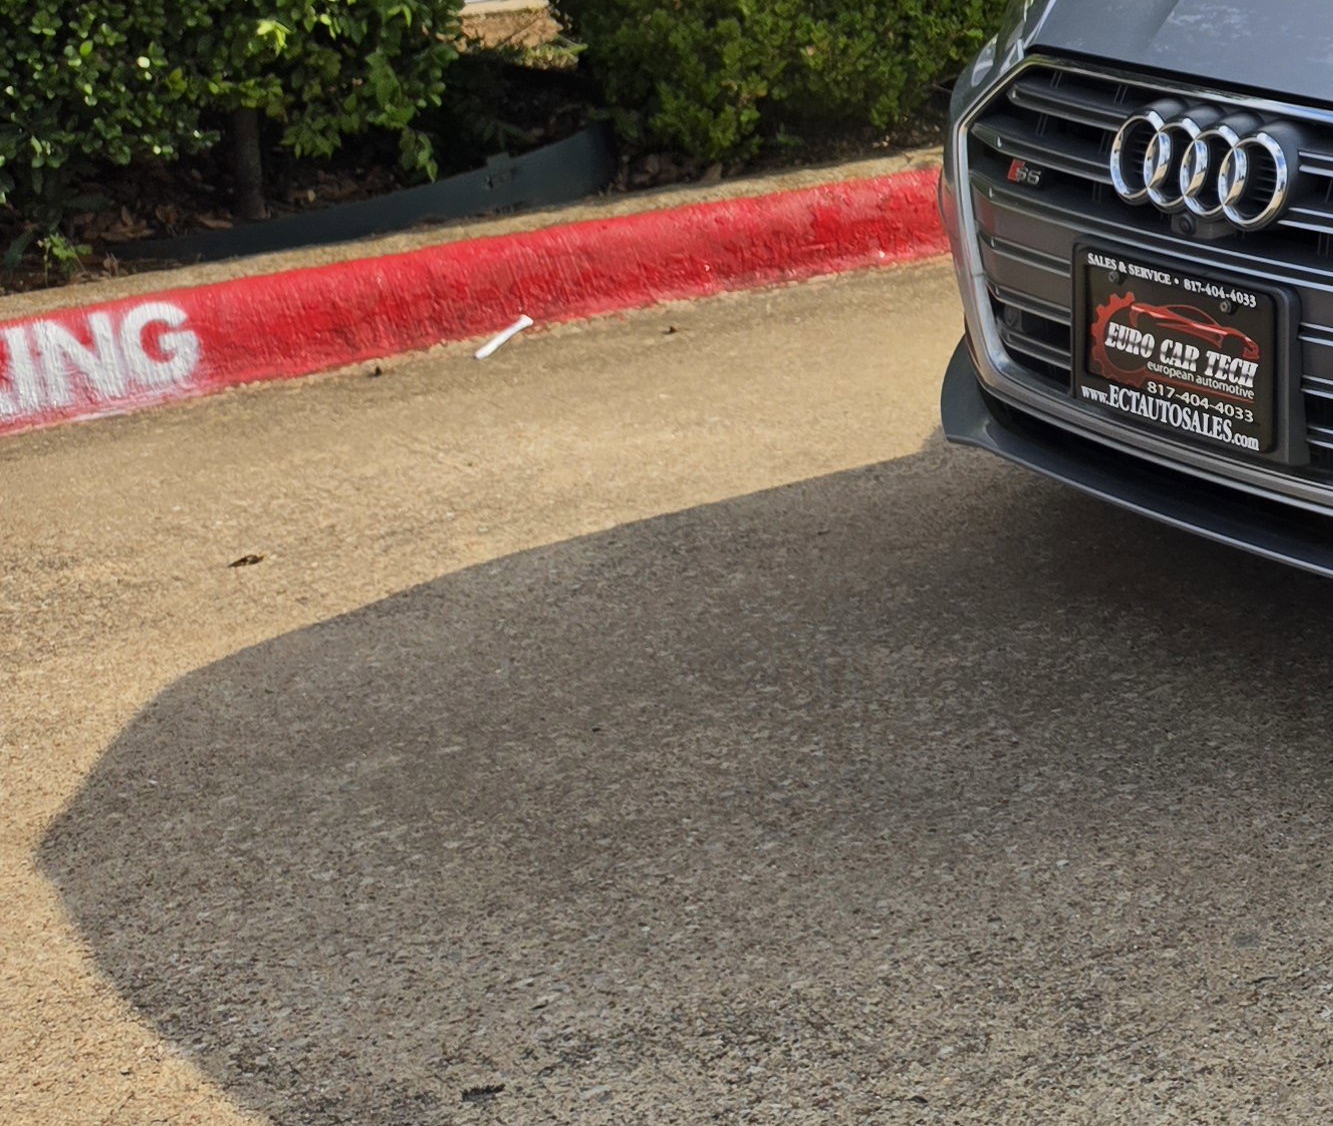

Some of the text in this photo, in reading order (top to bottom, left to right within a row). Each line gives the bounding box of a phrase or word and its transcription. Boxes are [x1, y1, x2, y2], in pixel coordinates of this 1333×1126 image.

[1087, 252, 1258, 308] SALES & SERVICE 817-404-4033
[0, 301, 202, 421] ING
[1104, 321, 1260, 388] EURO CAR TECH
[1146, 359, 1255, 400] european automotive
[1080, 383, 1260, 452] www.ECTAUTOSALES.com
[1146, 380, 1254, 424] 817-404-4033
